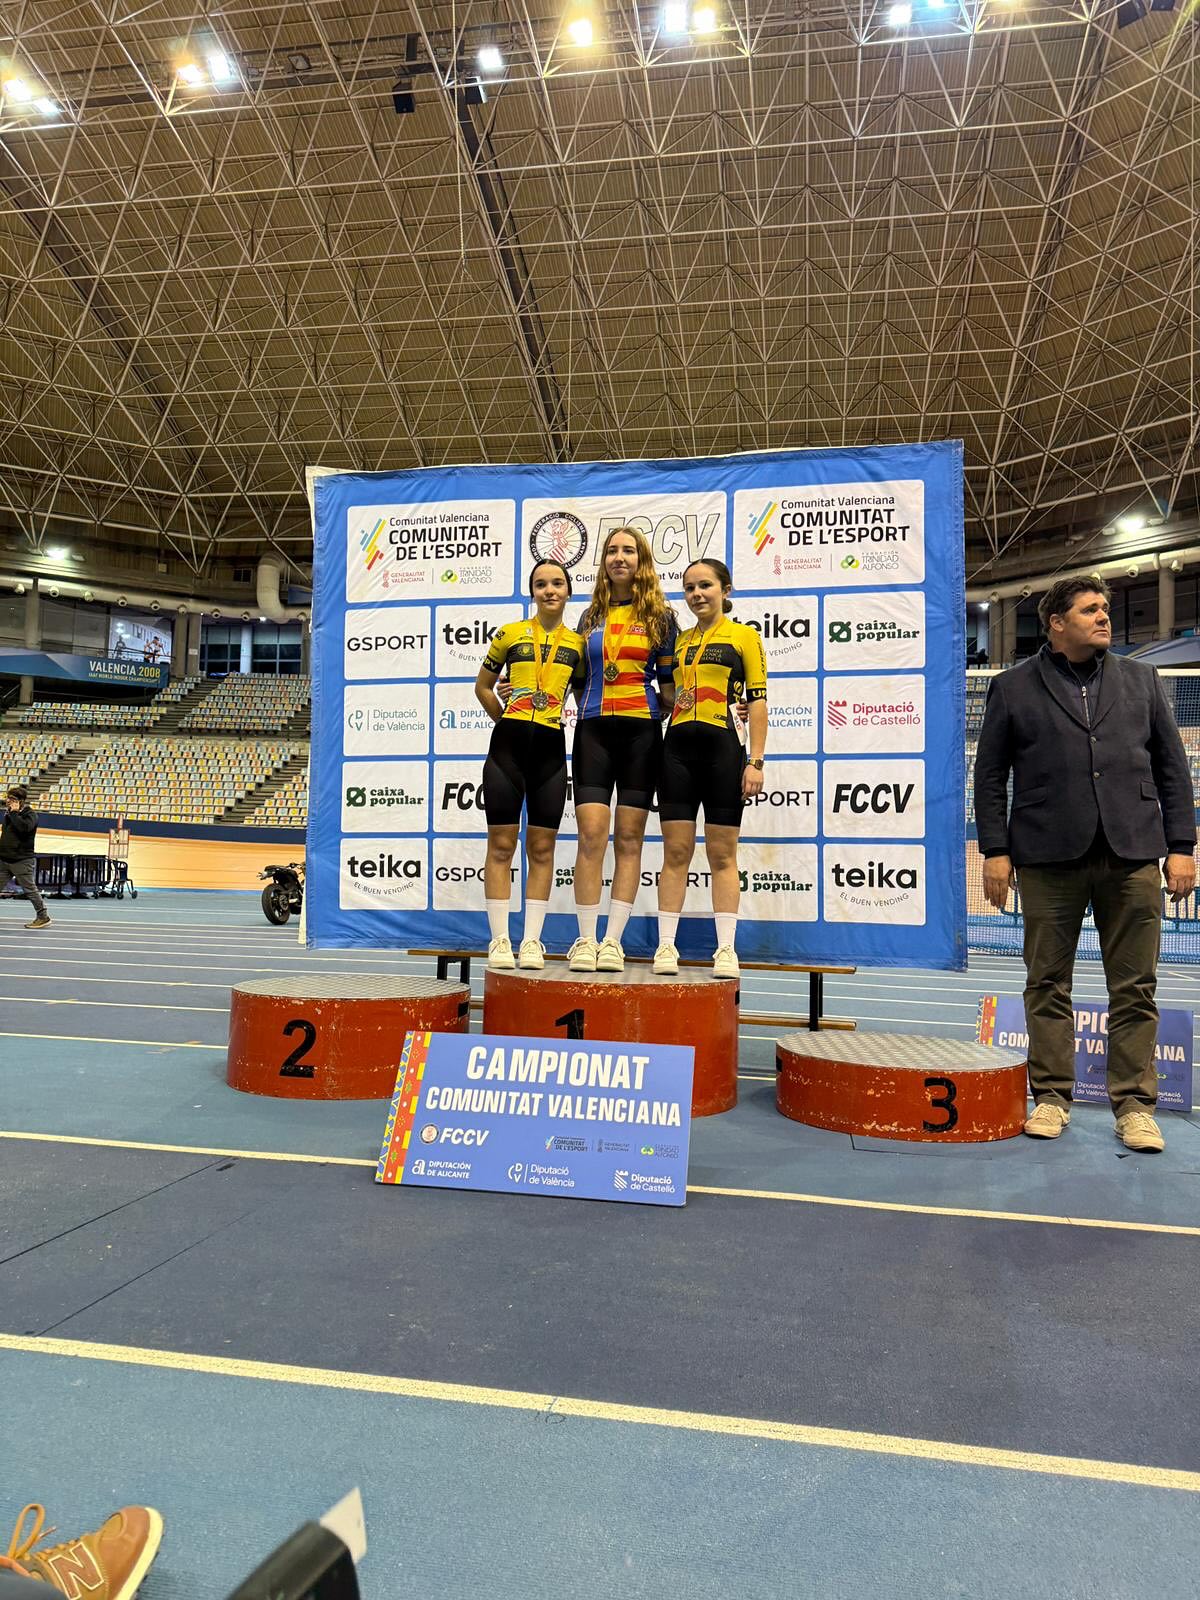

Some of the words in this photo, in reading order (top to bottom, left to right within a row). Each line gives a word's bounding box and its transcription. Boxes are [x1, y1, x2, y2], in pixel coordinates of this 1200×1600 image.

[782, 498, 835, 510] Comunitat
[838, 496, 895, 506] Valenciana
[390, 516, 437, 527] Comunitat
[440, 513, 489, 524] Valenciana
[780, 508, 895, 528] COMUNITAT
[389, 525, 489, 545] COMUNITAT
[788, 530, 813, 546] DE
[819, 525, 910, 545] L'ESPORT
[396, 546, 418, 561] DE
[422, 542, 502, 560] L'ESPORT
[783, 557, 822, 565] GENERALITAT
[862, 555, 899, 563] TRINIDAD
[862, 563, 899, 571] ALFONSO
[442, 620, 497, 645] teik
[856, 620, 897, 631] caixa
[856, 629, 920, 642] popular
[347, 635, 428, 651] GSPORT
[89, 660, 136, 675] VALENCIA
[139, 667, 160, 678] 2008
[485, 659, 498, 670] PV
[373, 709, 417, 721] Diputació
[852, 701, 914, 715] Diputació
[373, 722, 385, 731] de
[386, 721, 425, 731] València
[853, 716, 869, 726] de
[870, 714, 921, 726] Castelló
[370, 787, 404, 796] caixa
[832, 783, 915, 814] FCCV
[369, 796, 424, 807] popular
[743, 791, 814, 807] SPORT
[347, 853, 421, 878] teika
[752, 870, 791, 881] caixa
[831, 861, 917, 889] teika
[363, 886, 381, 895] BUEN
[384, 881, 414, 895] VENDING
[752, 881, 813, 893] popular
[839, 892, 849, 900] EL
[850, 896, 872, 907] BUEN
[873, 893, 909, 907] VENDING
[279, 1019, 317, 1078] 2
[466, 1046, 650, 1090] CAMPIONAT
[1077, 1081, 1105, 1091] Diputació
[425, 1086, 544, 1116] COMUNITAT
[548, 1094, 681, 1127] VALENCIANA
[922, 1077, 958, 1133] 3
[440, 1127, 490, 1146] FCCV
[554, 1138, 585, 1147] COMUNITAT
[428, 1160, 471, 1170] DIPUTACIÓN
[531, 1164, 569, 1176] Diputació
[436, 1170, 470, 1179] ALICANTE
[631, 1173, 672, 1185] Diputació
[529, 1176, 540, 1184] de
[541, 1176, 575, 1188] València
[630, 1182, 641, 1190] de
[642, 1183, 675, 1194] Castelló
[49, 1542, 104, 1600] N
